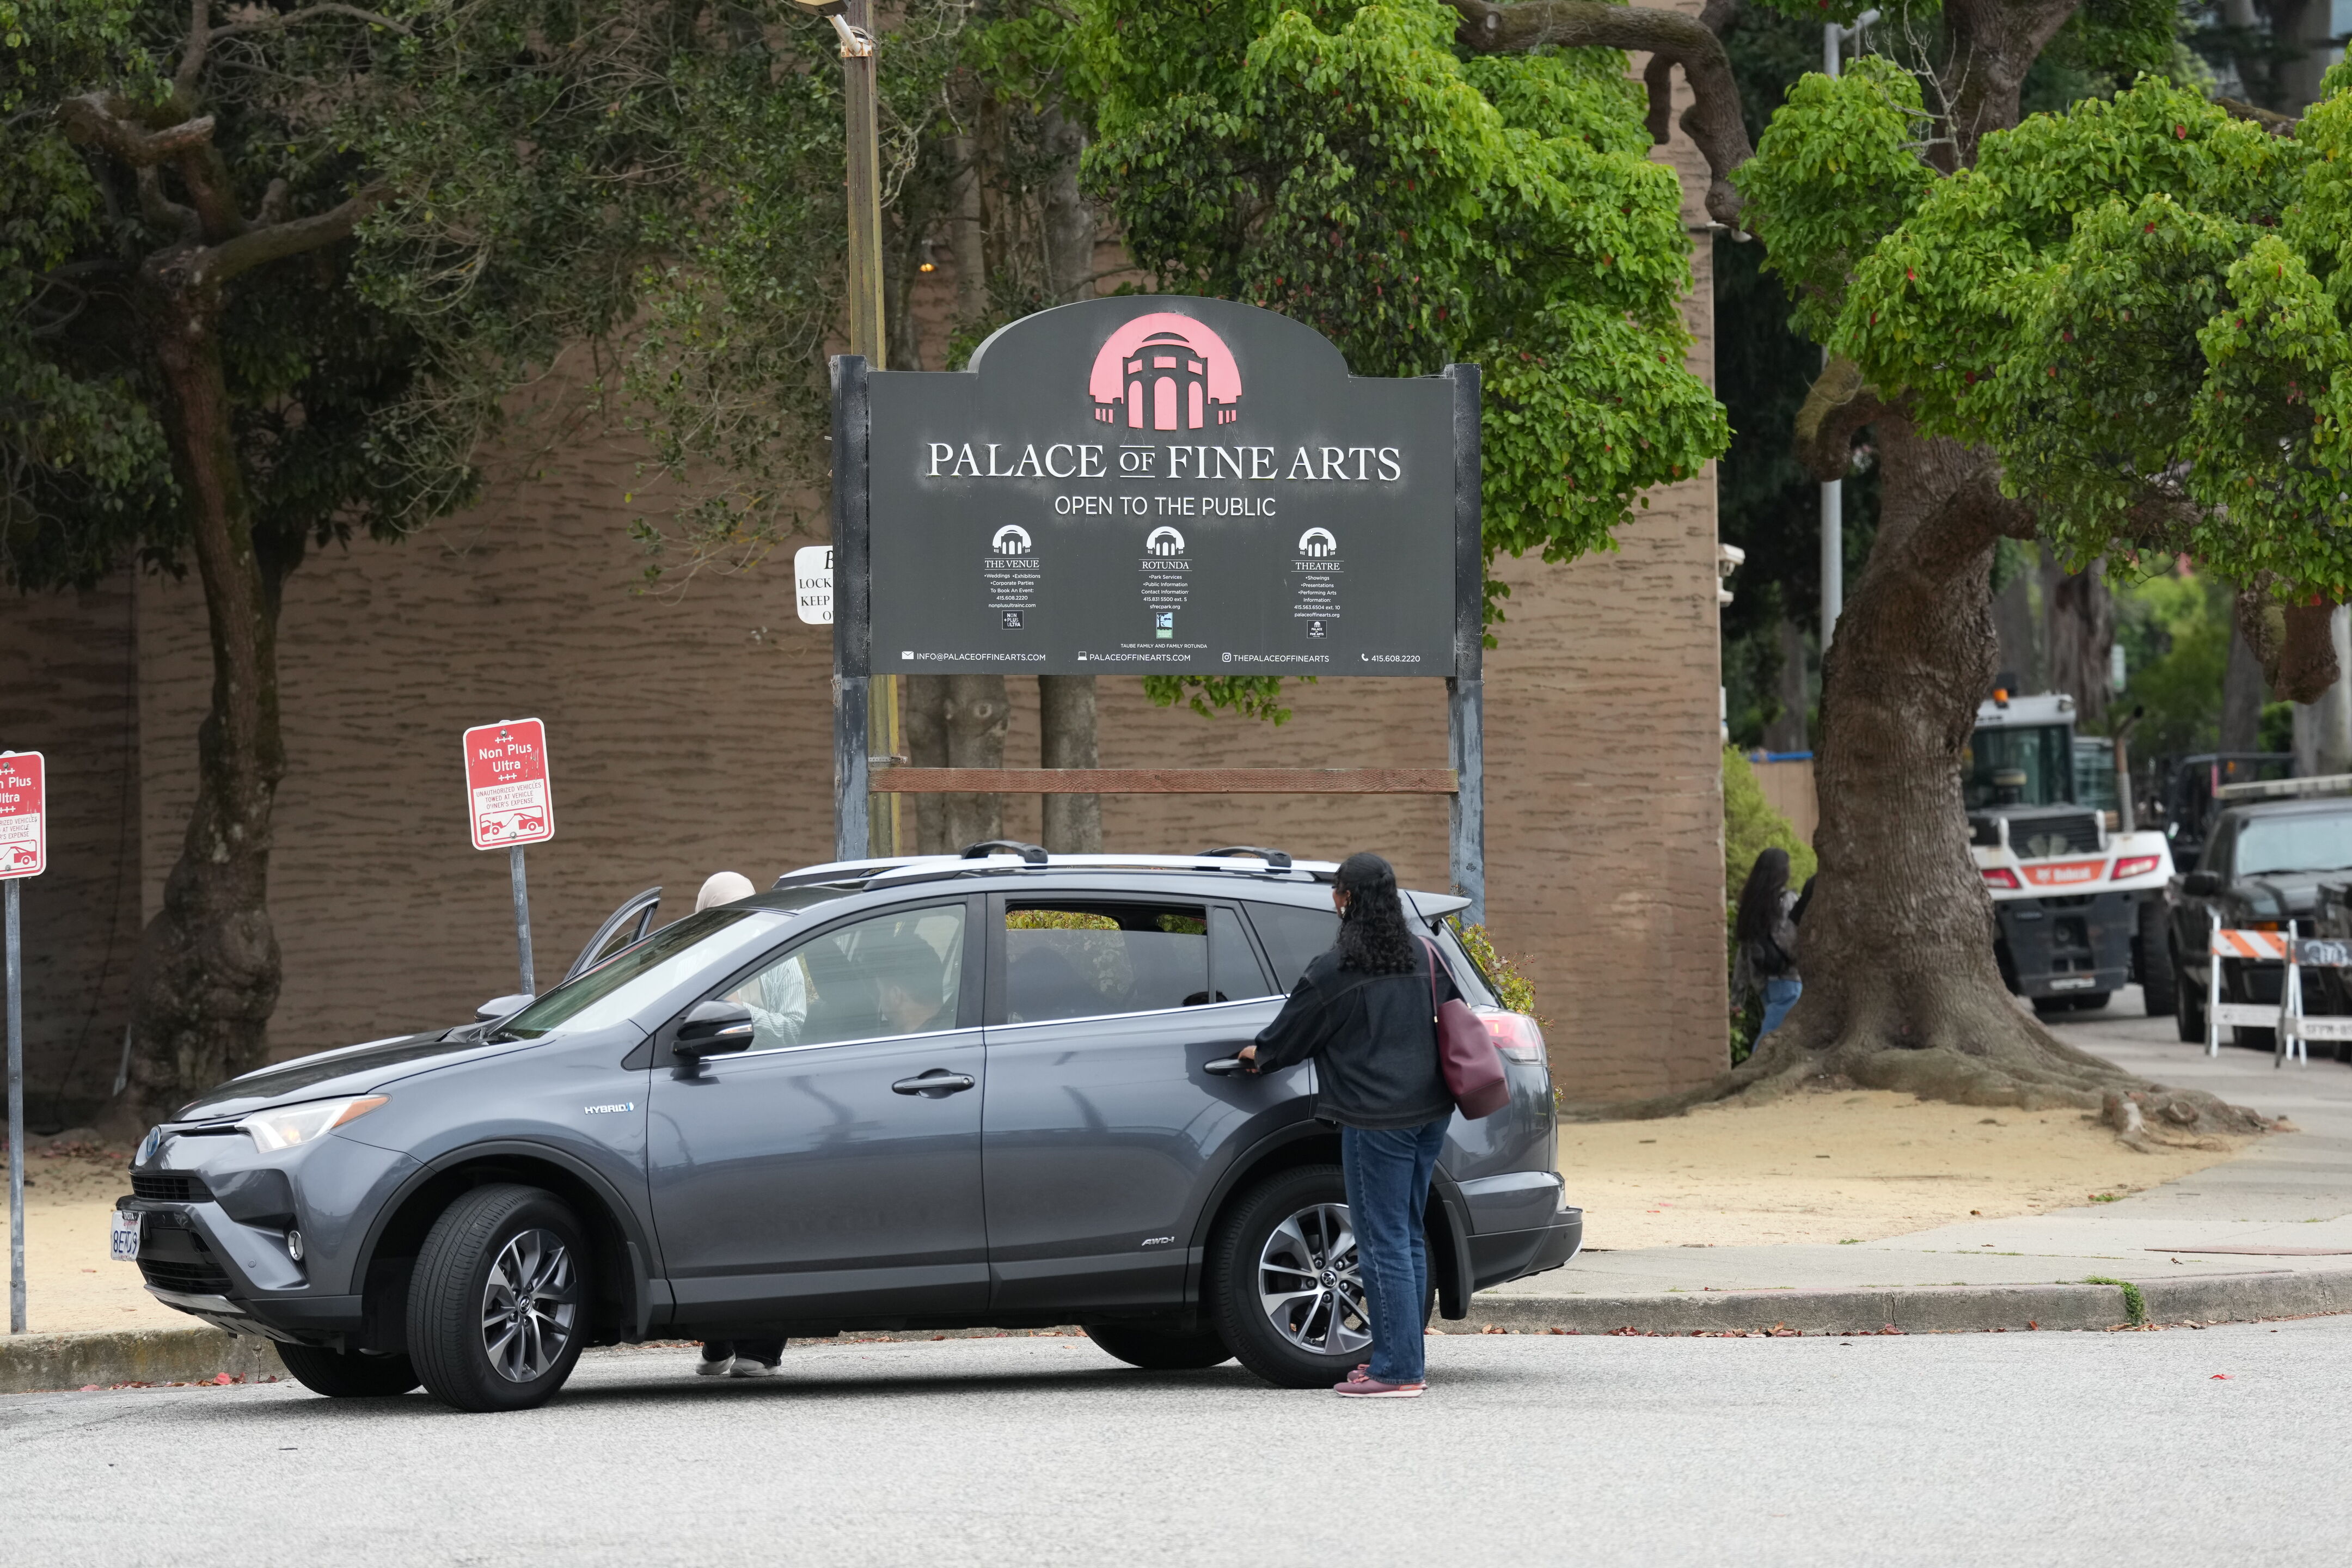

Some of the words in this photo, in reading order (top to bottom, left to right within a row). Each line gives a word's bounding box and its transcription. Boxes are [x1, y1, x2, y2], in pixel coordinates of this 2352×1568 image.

[927, 443, 1107, 478] PALACE
[1120, 451, 1155, 471] OF
[1166, 446, 1278, 480] FINE
[1286, 447, 1401, 481] ARTS
[1055, 496, 1112, 515] OPEN
[1120, 497, 1148, 515] TO
[1155, 497, 1195, 516] THE
[1202, 498, 1276, 517] PUBLIC
[1142, 561, 1190, 569] ROTUNDA
[1295, 562, 1340, 571] THEATRE
[799, 578, 832, 589] LOCK
[801, 596, 830, 606] KEEP
[479, 748, 503, 760] Non
[507, 743, 532, 756] Plus
[493, 760, 520, 773] Ultra
[9, 776, 32, 788] Plus
[476, 786, 515, 797] UNAUTHORIZED
[517, 782, 542, 791] VEHICLES
[0, 792, 20, 804] ltra
[15, 816, 38, 825] VEHICLES
[8, 831, 29, 839] EXPENSE
[585, 1104, 627, 1114] HYBRID
[1142, 1236, 1174, 1246] AWD-i
